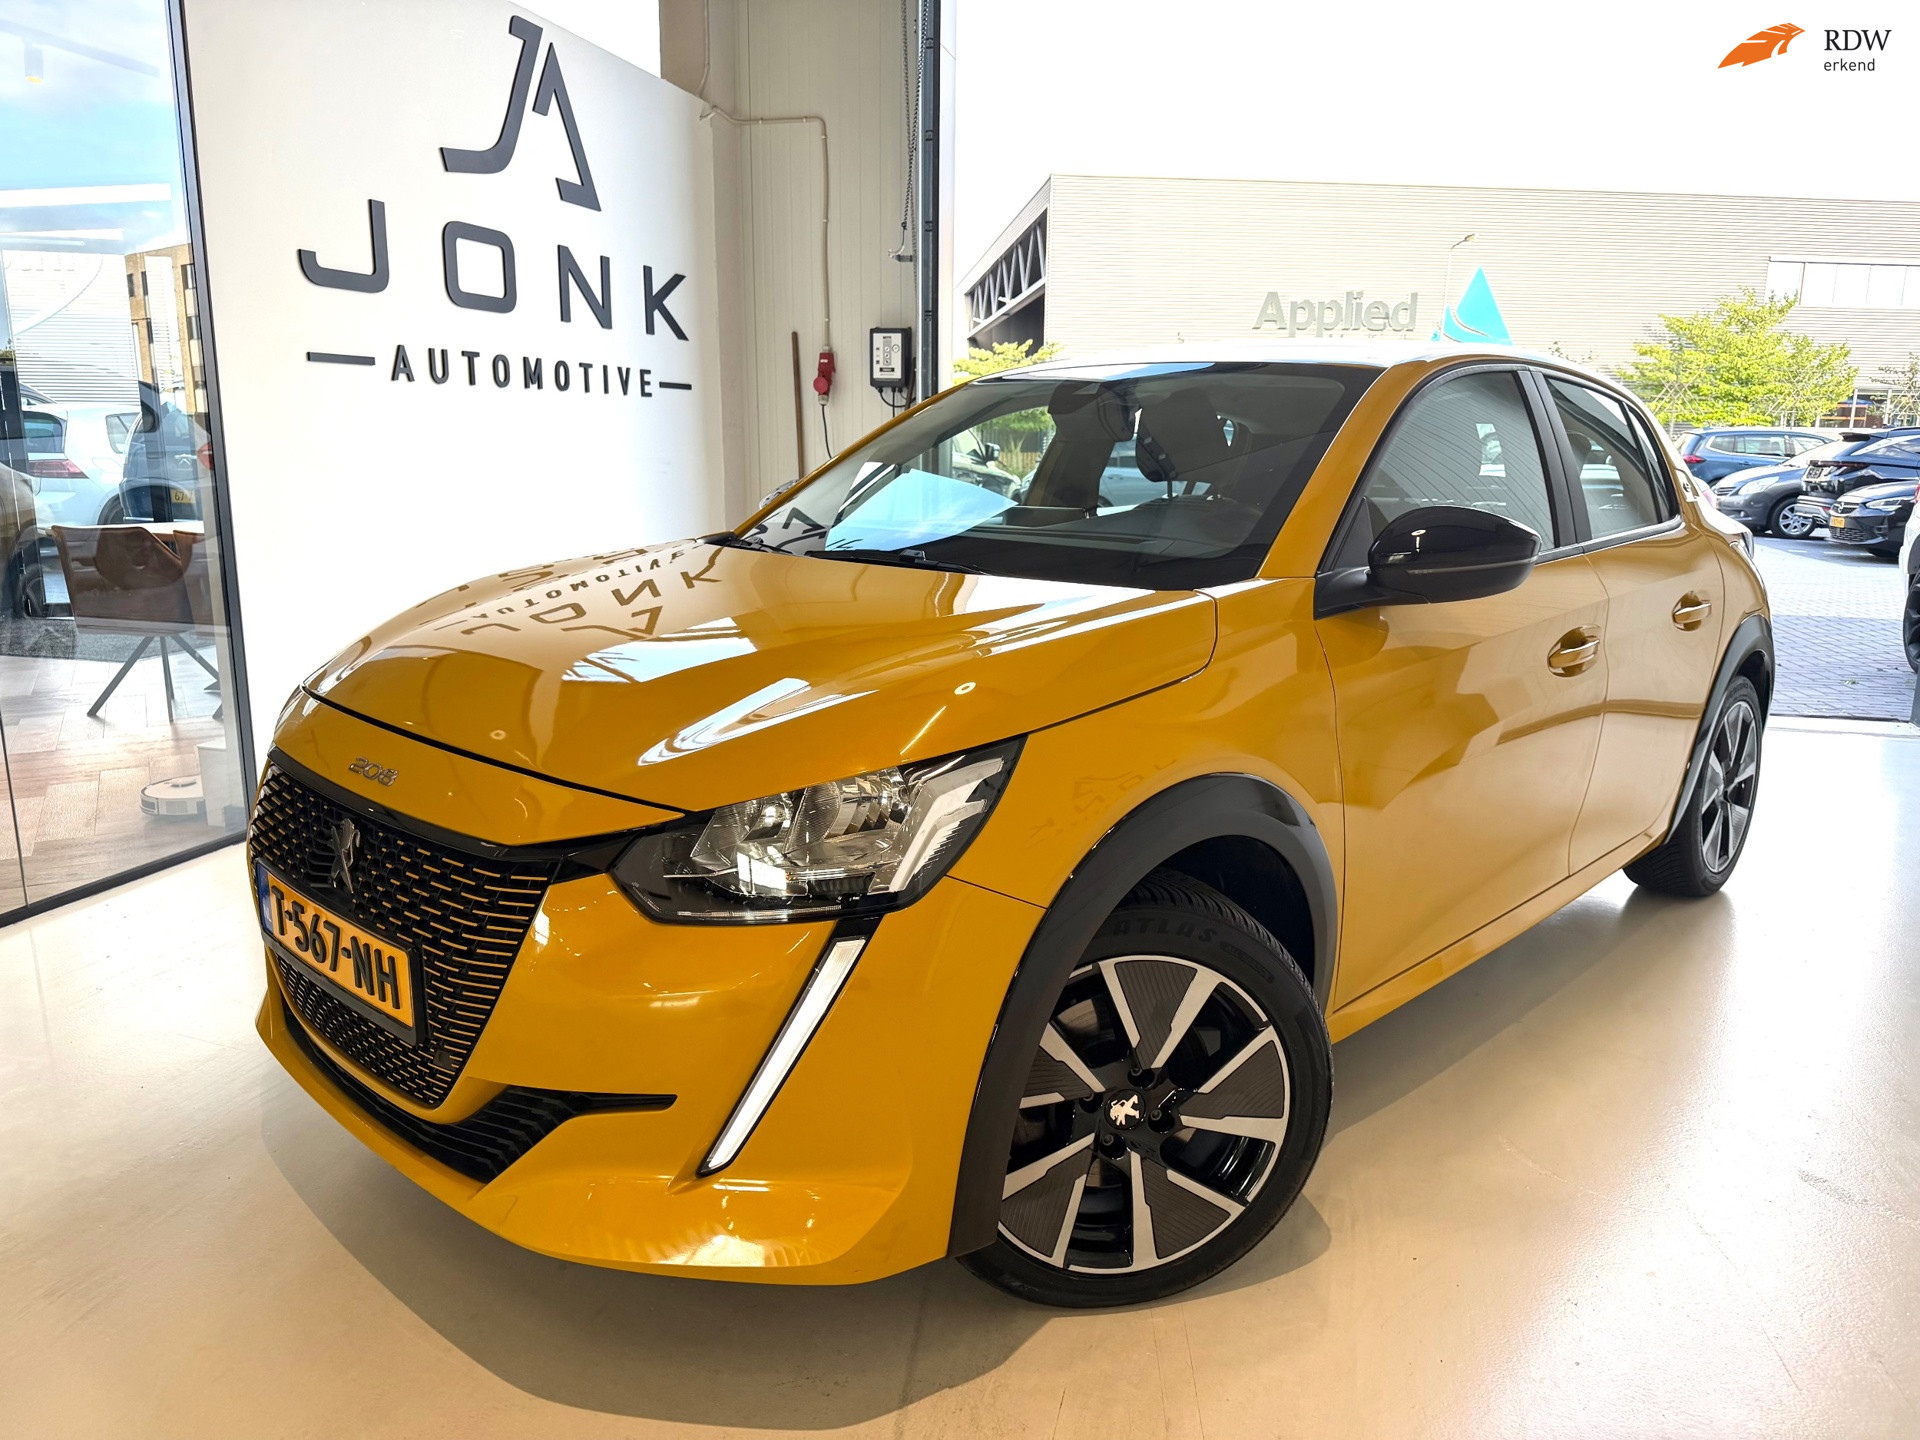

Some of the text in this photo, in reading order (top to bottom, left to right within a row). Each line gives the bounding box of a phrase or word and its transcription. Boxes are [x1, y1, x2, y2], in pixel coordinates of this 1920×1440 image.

[297, 198, 690, 342] JONK
[1252, 290, 1418, 338] Applied
[391, 344, 654, 398] AUTOMOTIVE
[348, 756, 399, 787] 208
[271, 885, 401, 1010] T-567-NH
[1113, 918, 1218, 943] ATLAS
